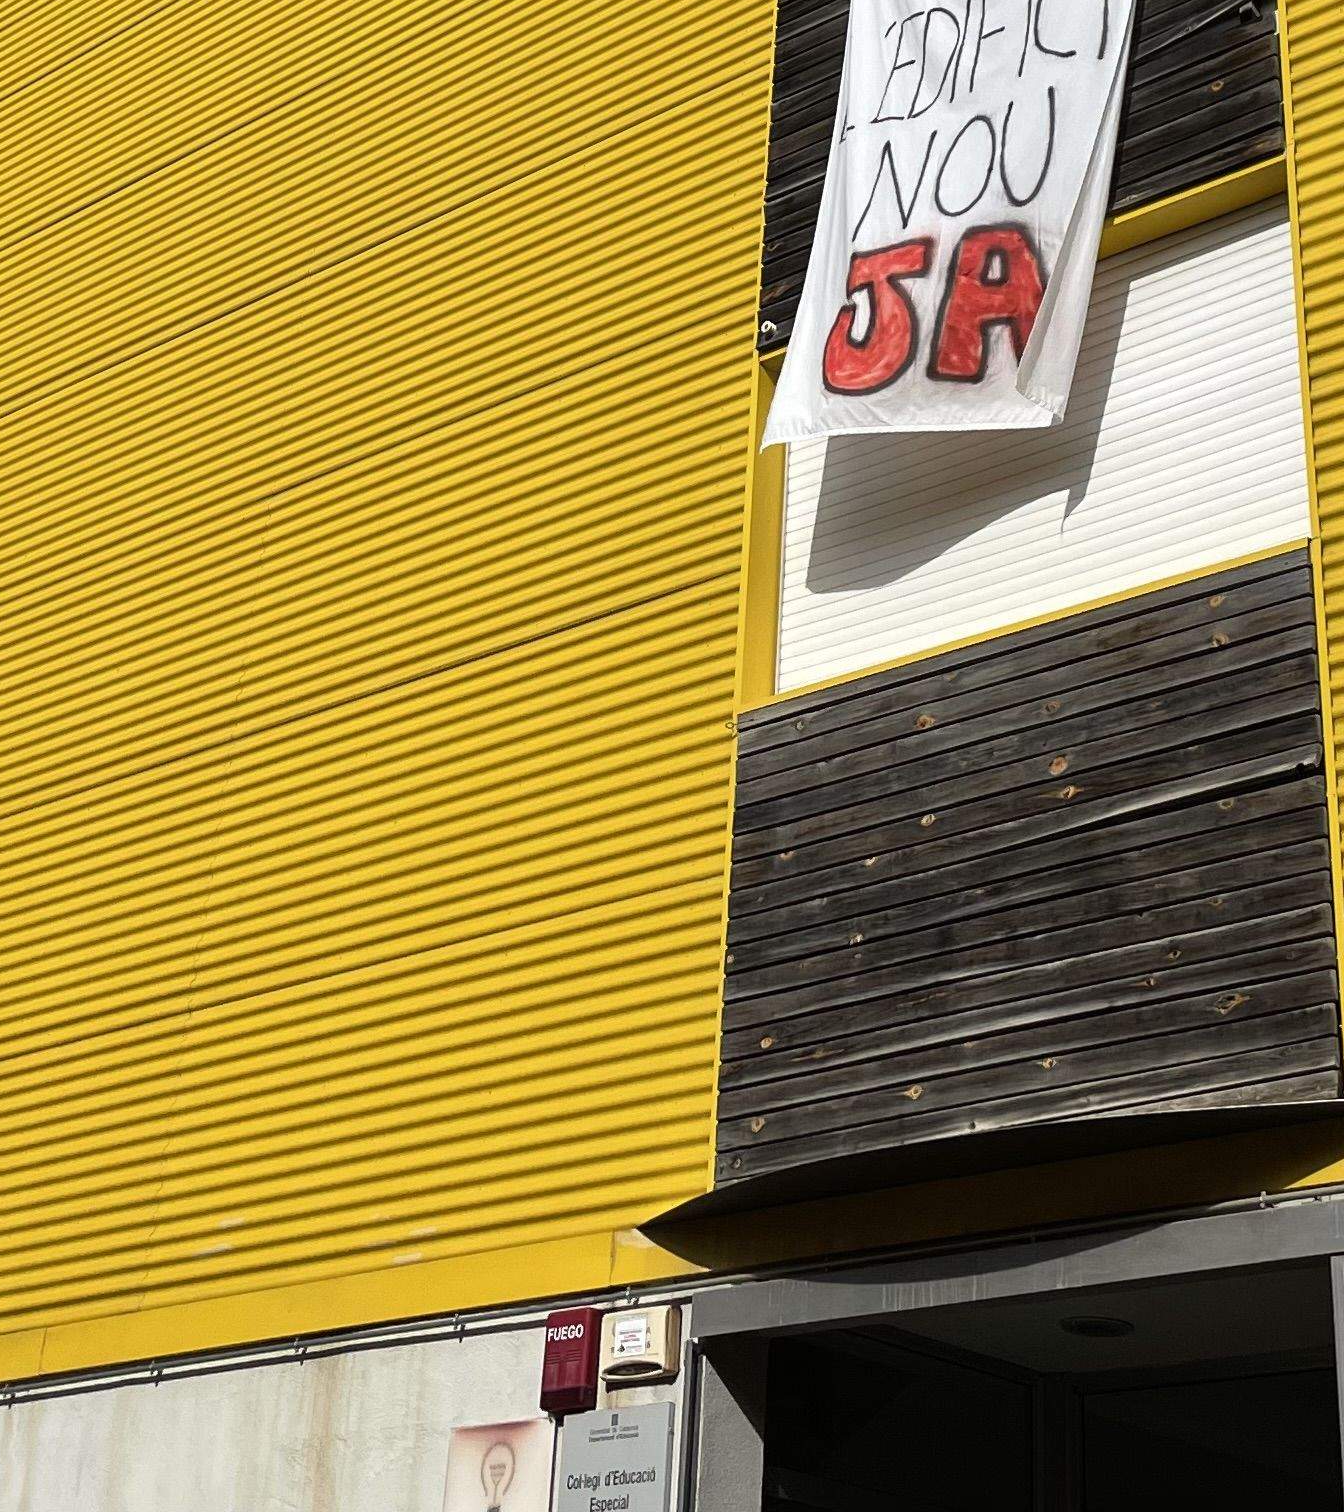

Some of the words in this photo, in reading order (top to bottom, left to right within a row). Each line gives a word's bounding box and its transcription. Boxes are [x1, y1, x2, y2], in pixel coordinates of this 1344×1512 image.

[851, 85, 1055, 242] NOU
[821, 222, 1049, 396] JA
[547, 1323, 585, 1342] FUEGO
[604, 1466, 656, 1487] d'Educació
[589, 1493, 630, 1512] Especial
